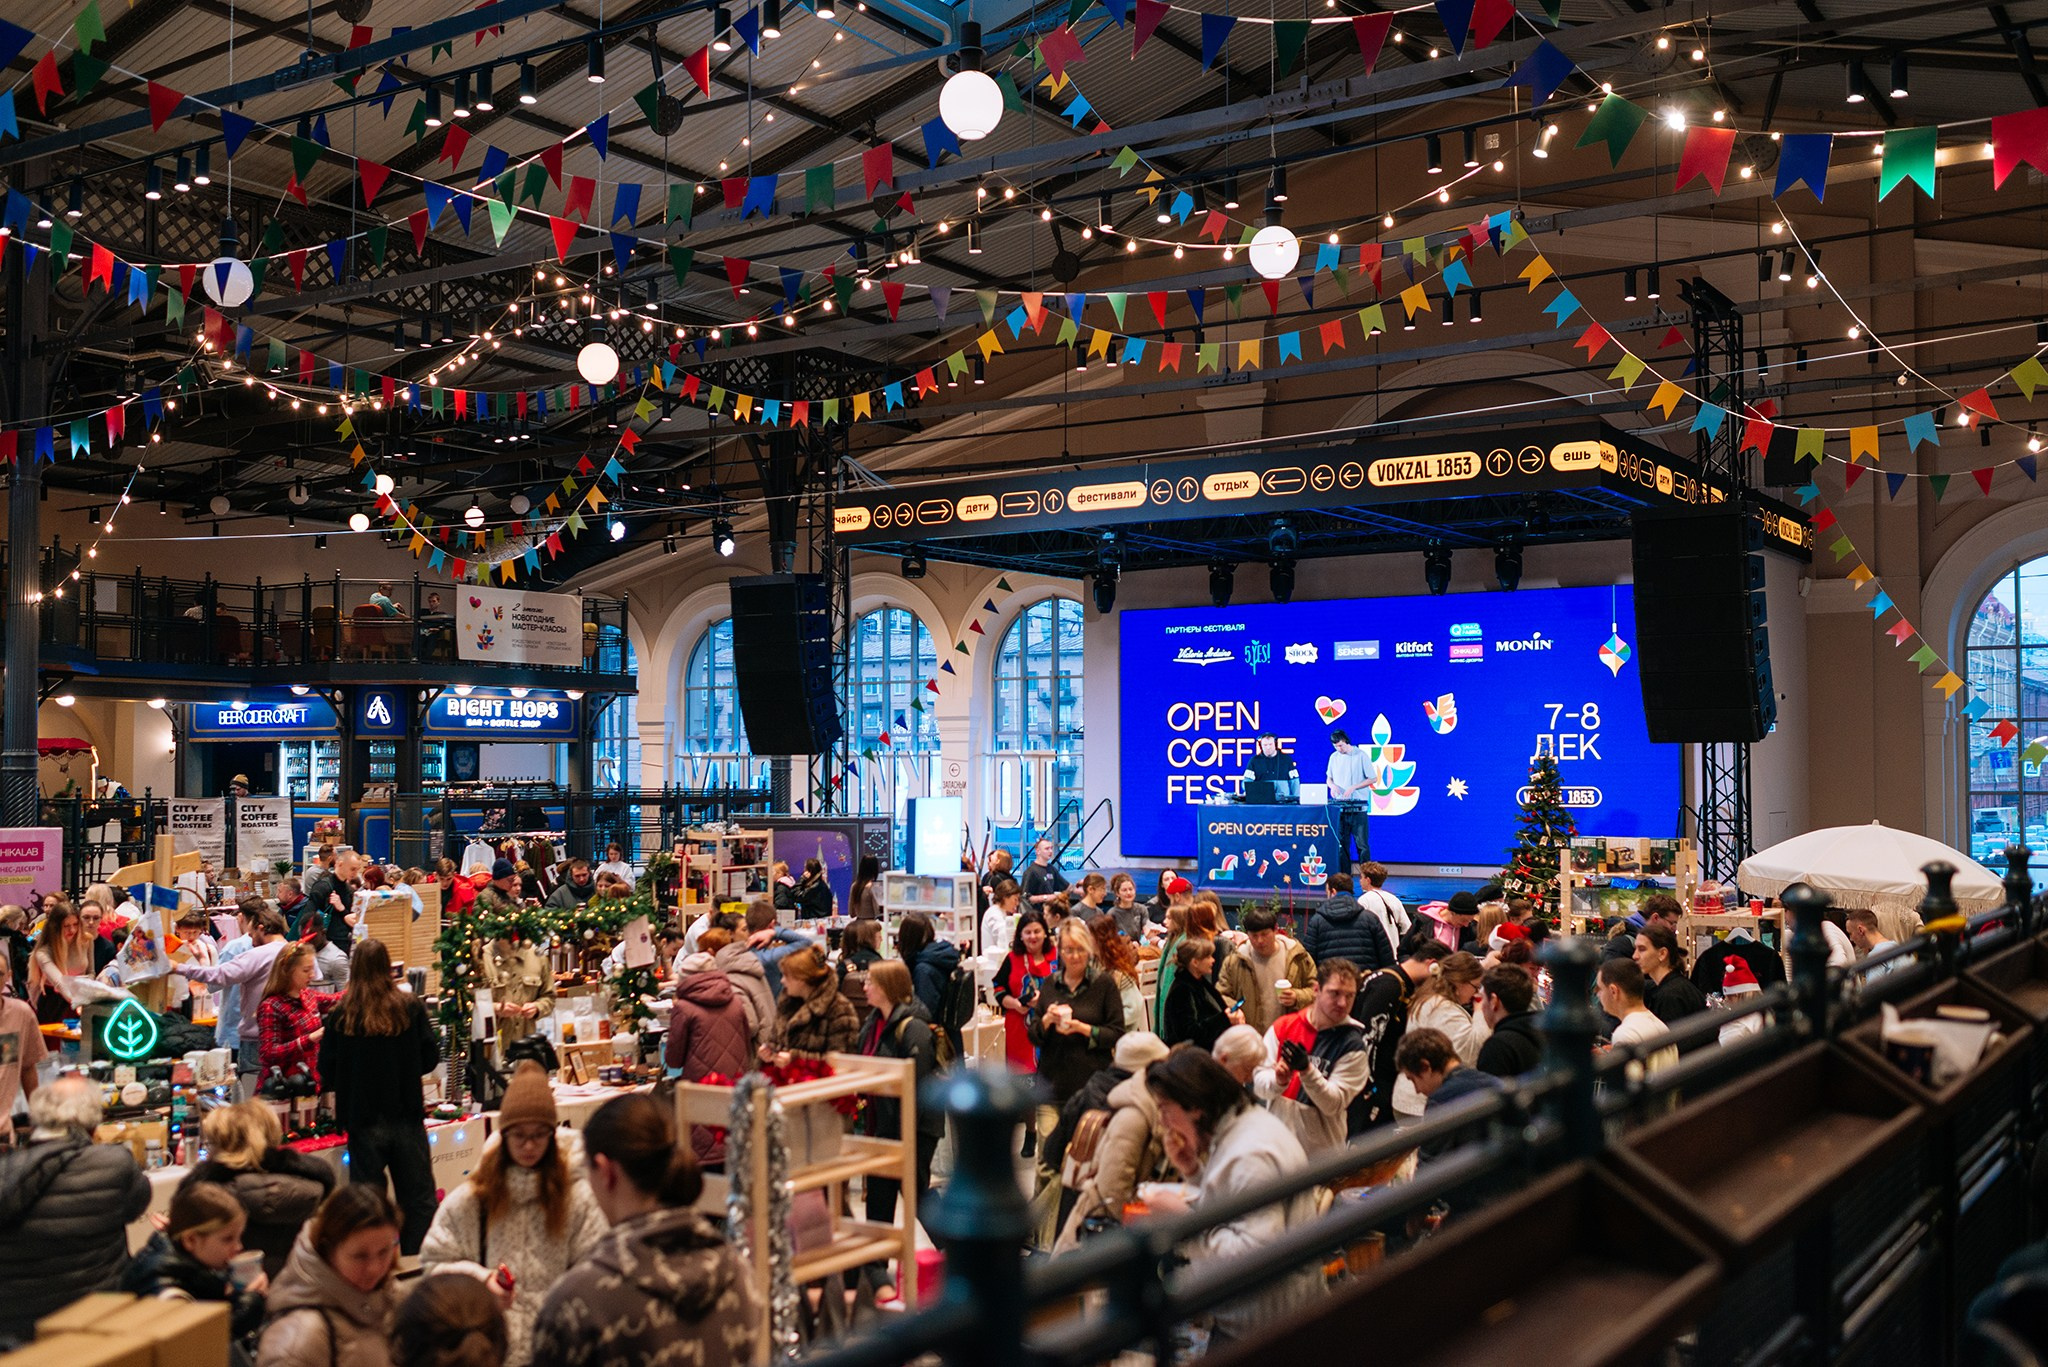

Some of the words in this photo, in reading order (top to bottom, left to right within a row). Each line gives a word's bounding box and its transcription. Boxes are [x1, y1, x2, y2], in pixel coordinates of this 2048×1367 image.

[1562, 450, 1592, 462] ешь
[1376, 460, 1432, 483] VOKZAL
[1436, 458, 1473, 478] 1853
[1213, 479, 1250, 492] отдых
[1077, 490, 1138, 505] фестивали
[965, 503, 990, 515] дети
[511, 613, 556, 624] НОВОГОДНИЕ
[511, 622, 567, 634] МАСТЕР-КЛАССЫ
[1165, 626, 1202, 634] ПАРТНЕРЫ
[1202, 623, 1246, 633] ФЕСТИВАЛЯ
[1395, 641, 1434, 653] Kitfort
[1496, 634, 1552, 652] MONIN
[1337, 647, 1365, 657] SENSE
[447, 698, 505, 717] RIGHT
[510, 700, 559, 719] HOPS
[219, 710, 244, 725] BEER
[272, 708, 308, 724] CRAFT
[1167, 701, 1260, 732] OPEN
[1544, 702, 1601, 730] 7-8
[466, 718, 483, 727] BAR
[490, 719, 519, 728] BOTTLE
[519, 719, 541, 728] SHOP
[1167, 738, 1297, 768] COFFE
[1530, 733, 1602, 765] ДЕК
[1167, 775, 1246, 804] FEST
[1568, 790, 1595, 804] 1853
[172, 805, 199, 813] CITY
[240, 805, 265, 813] CITY
[172, 814, 213, 822] COFFEE
[240, 813, 278, 821] COFFEE
[1208, 822, 1243, 835] OPEN
[1245, 823, 1294, 836] COFFEE
[1296, 824, 1329, 837] FEST
[455, 1147, 474, 1160] FEST
